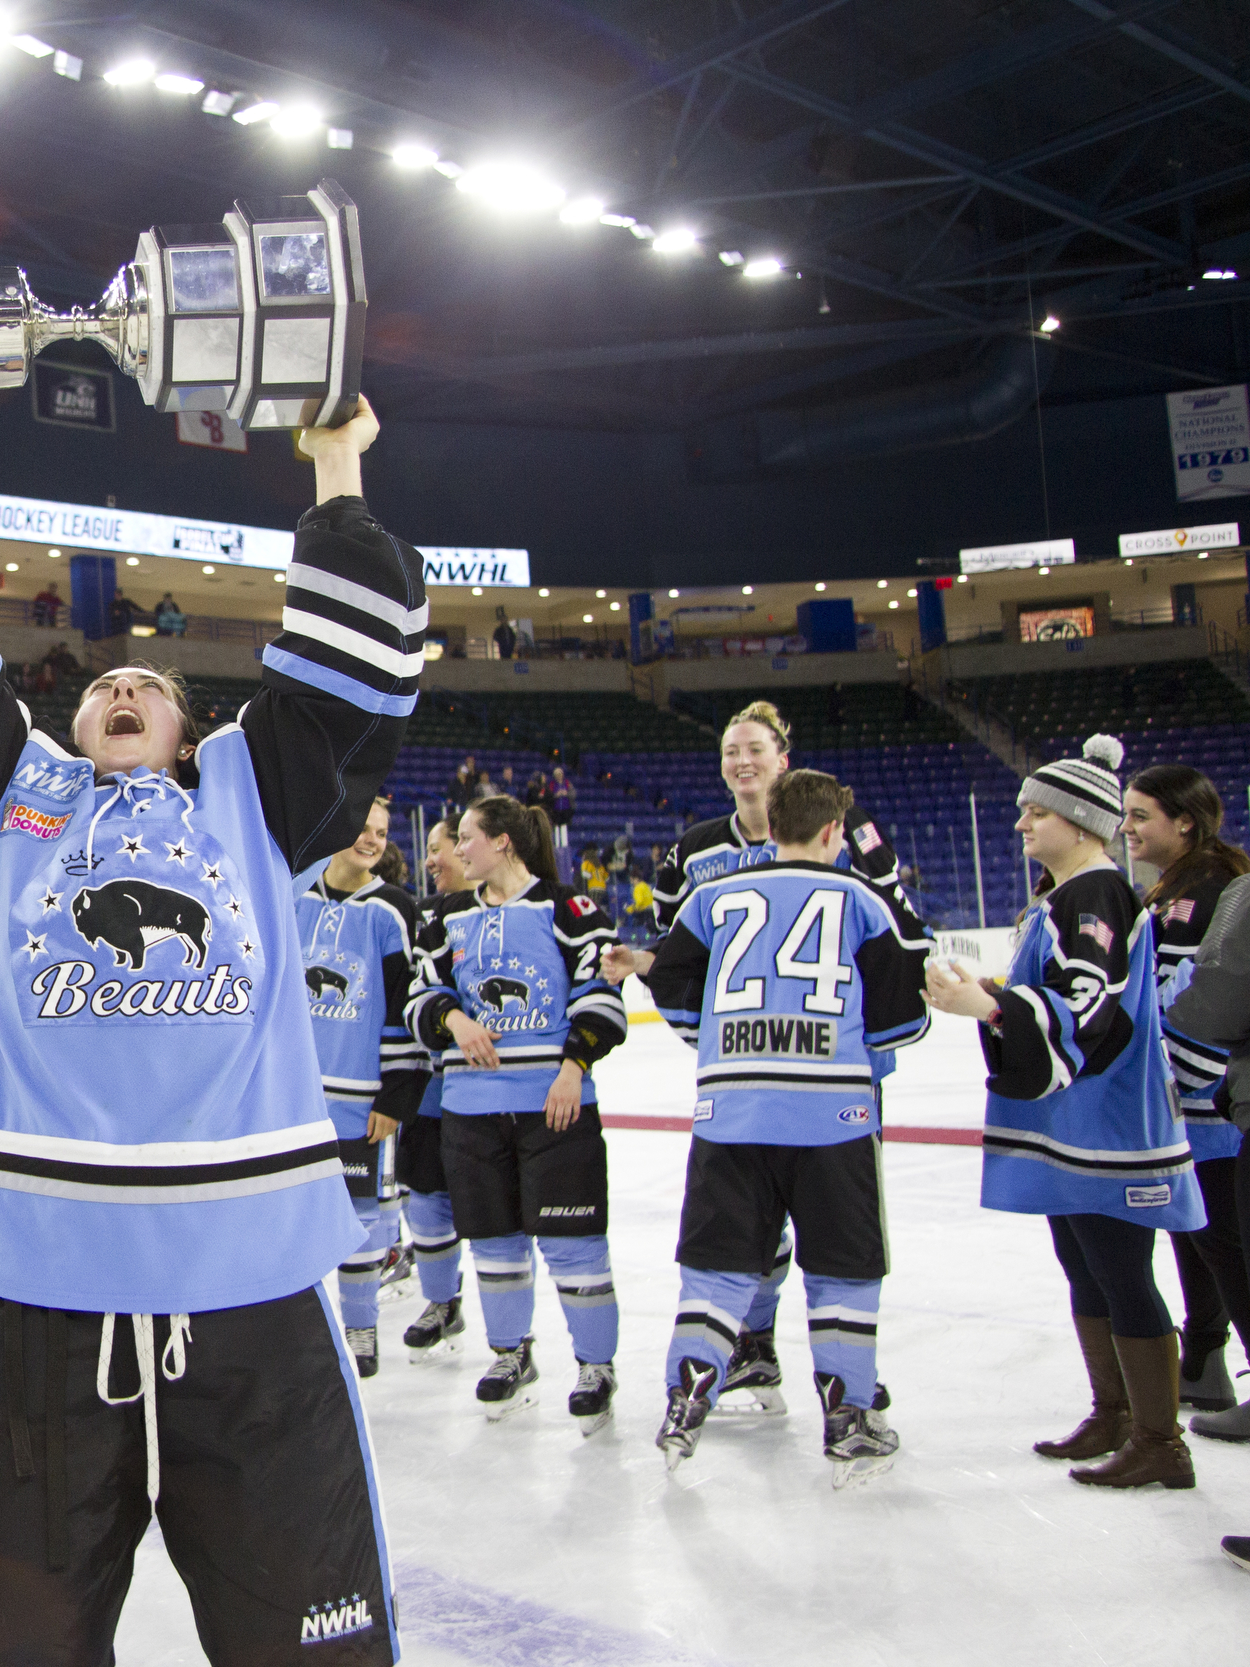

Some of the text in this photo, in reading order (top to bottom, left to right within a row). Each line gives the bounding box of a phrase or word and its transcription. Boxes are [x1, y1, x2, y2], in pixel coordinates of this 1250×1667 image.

[62, 513, 124, 542] LEAGUE
[1126, 530, 1234, 551] CROSS POINT
[424, 562, 513, 583] NWHL
[11, 817, 62, 839] DONUTS
[710, 887, 853, 1017] 24
[31, 960, 253, 1019] Beauts
[722, 1018, 830, 1055] BROWNE
[539, 1205, 596, 1217] BAUER
[301, 1599, 372, 1639] NWHL
